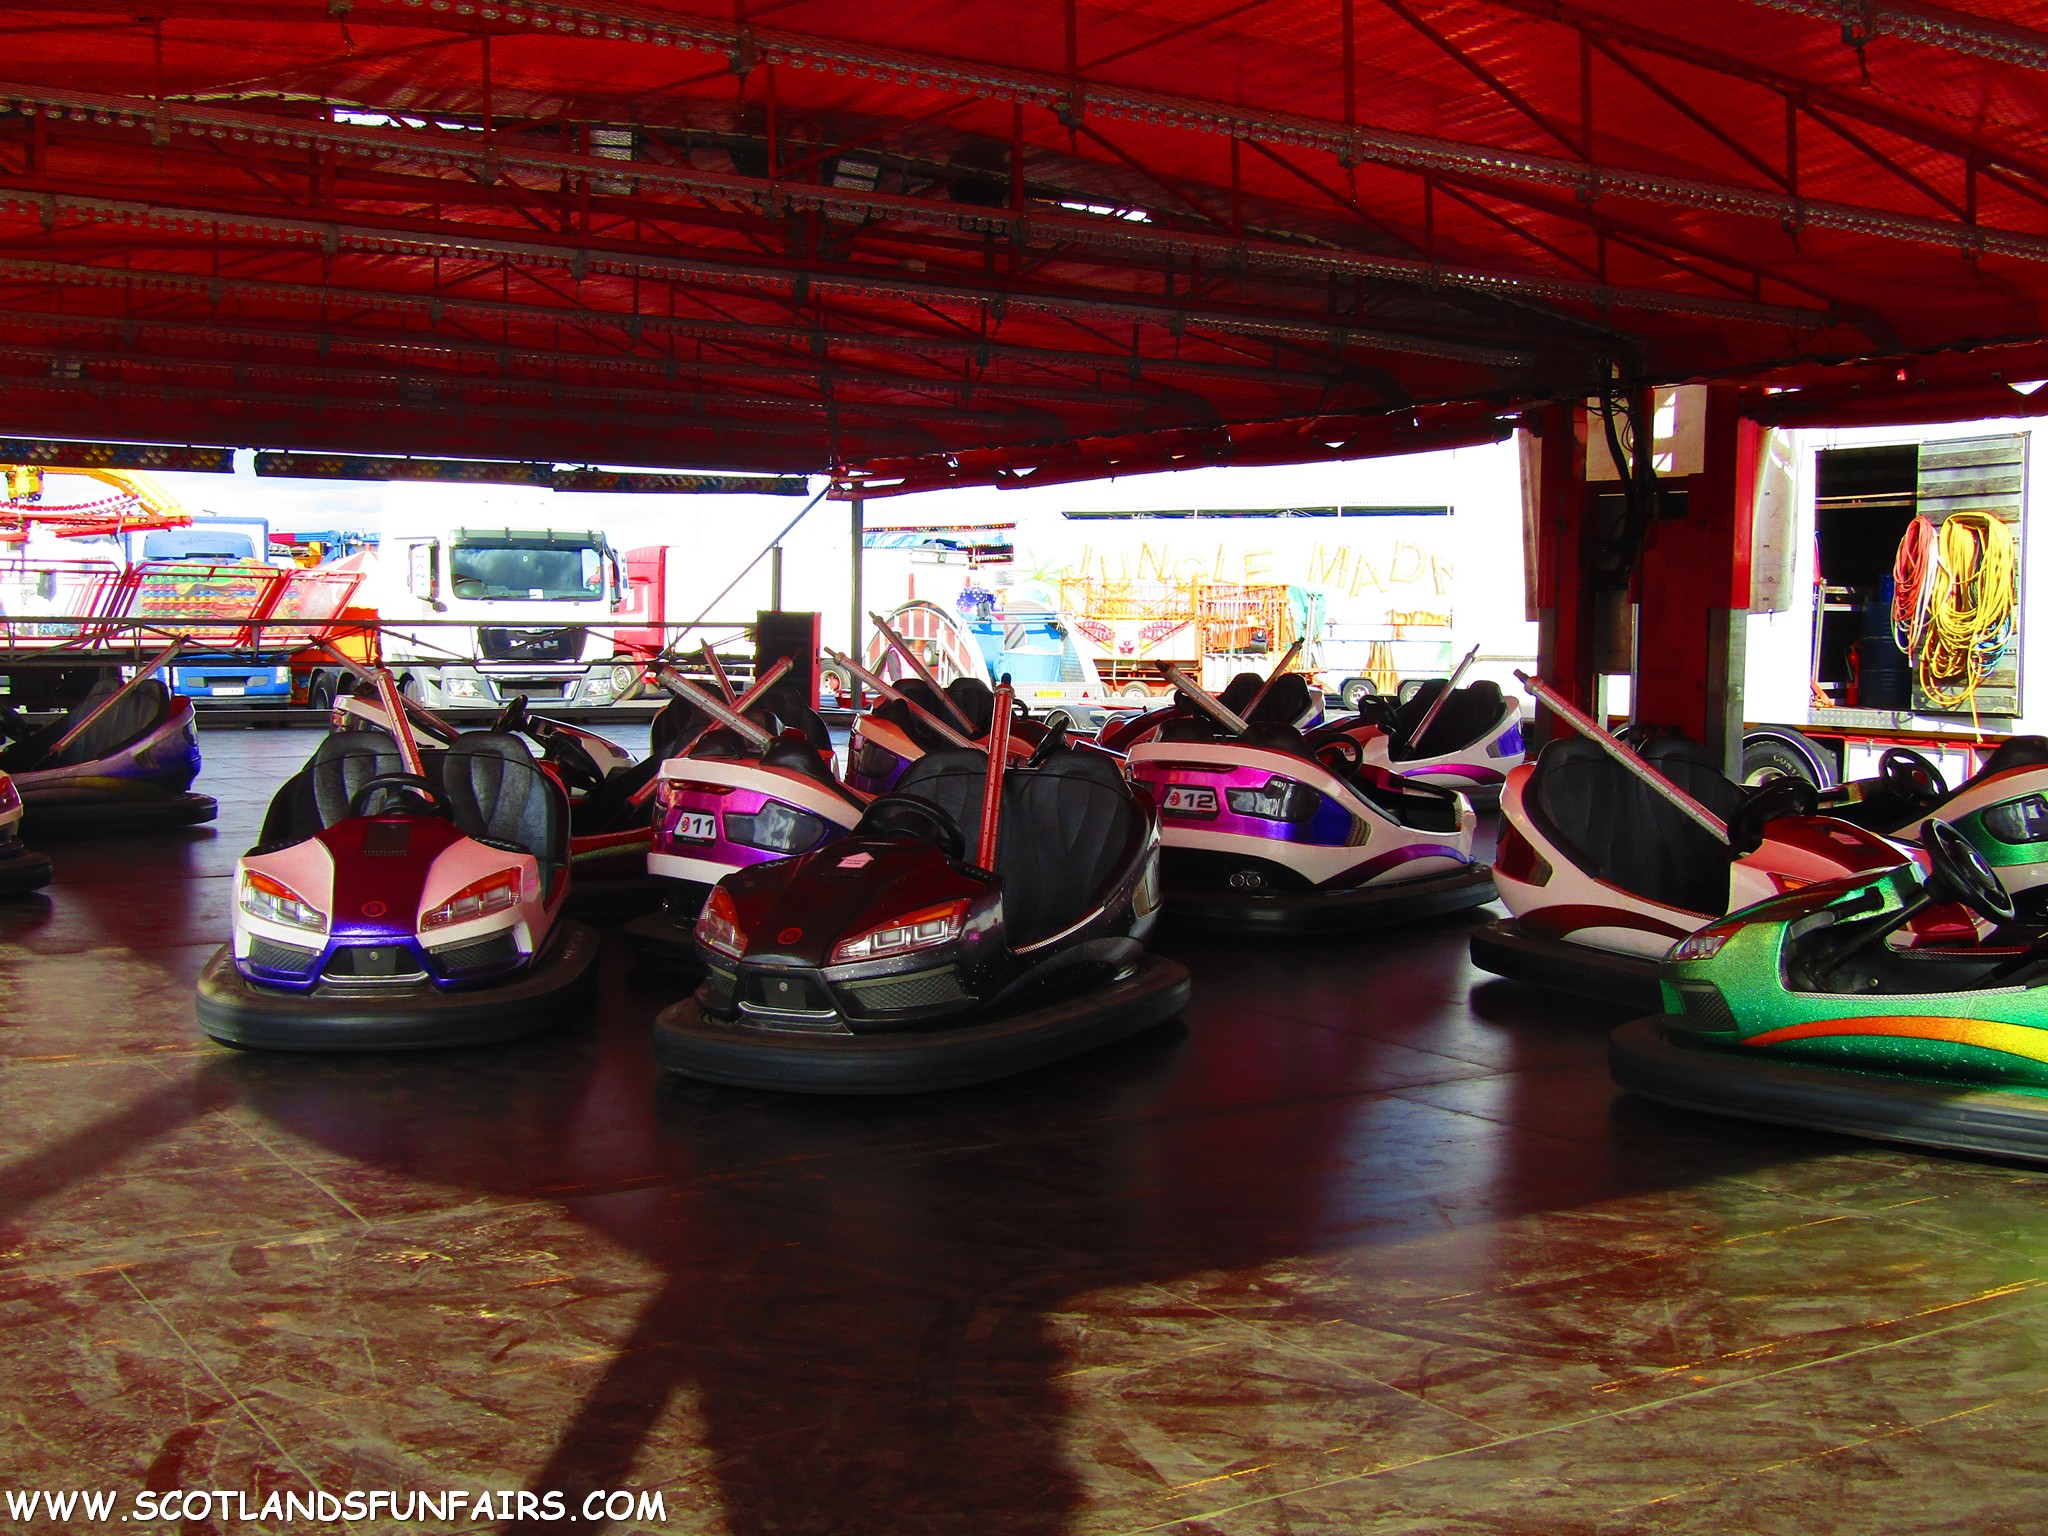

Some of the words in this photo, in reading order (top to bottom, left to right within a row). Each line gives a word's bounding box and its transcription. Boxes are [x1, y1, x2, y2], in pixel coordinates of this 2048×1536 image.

[1066, 541, 1273, 592] JUNGLE
[1184, 793, 1213, 808] 12
[692, 817, 714, 836] 11
